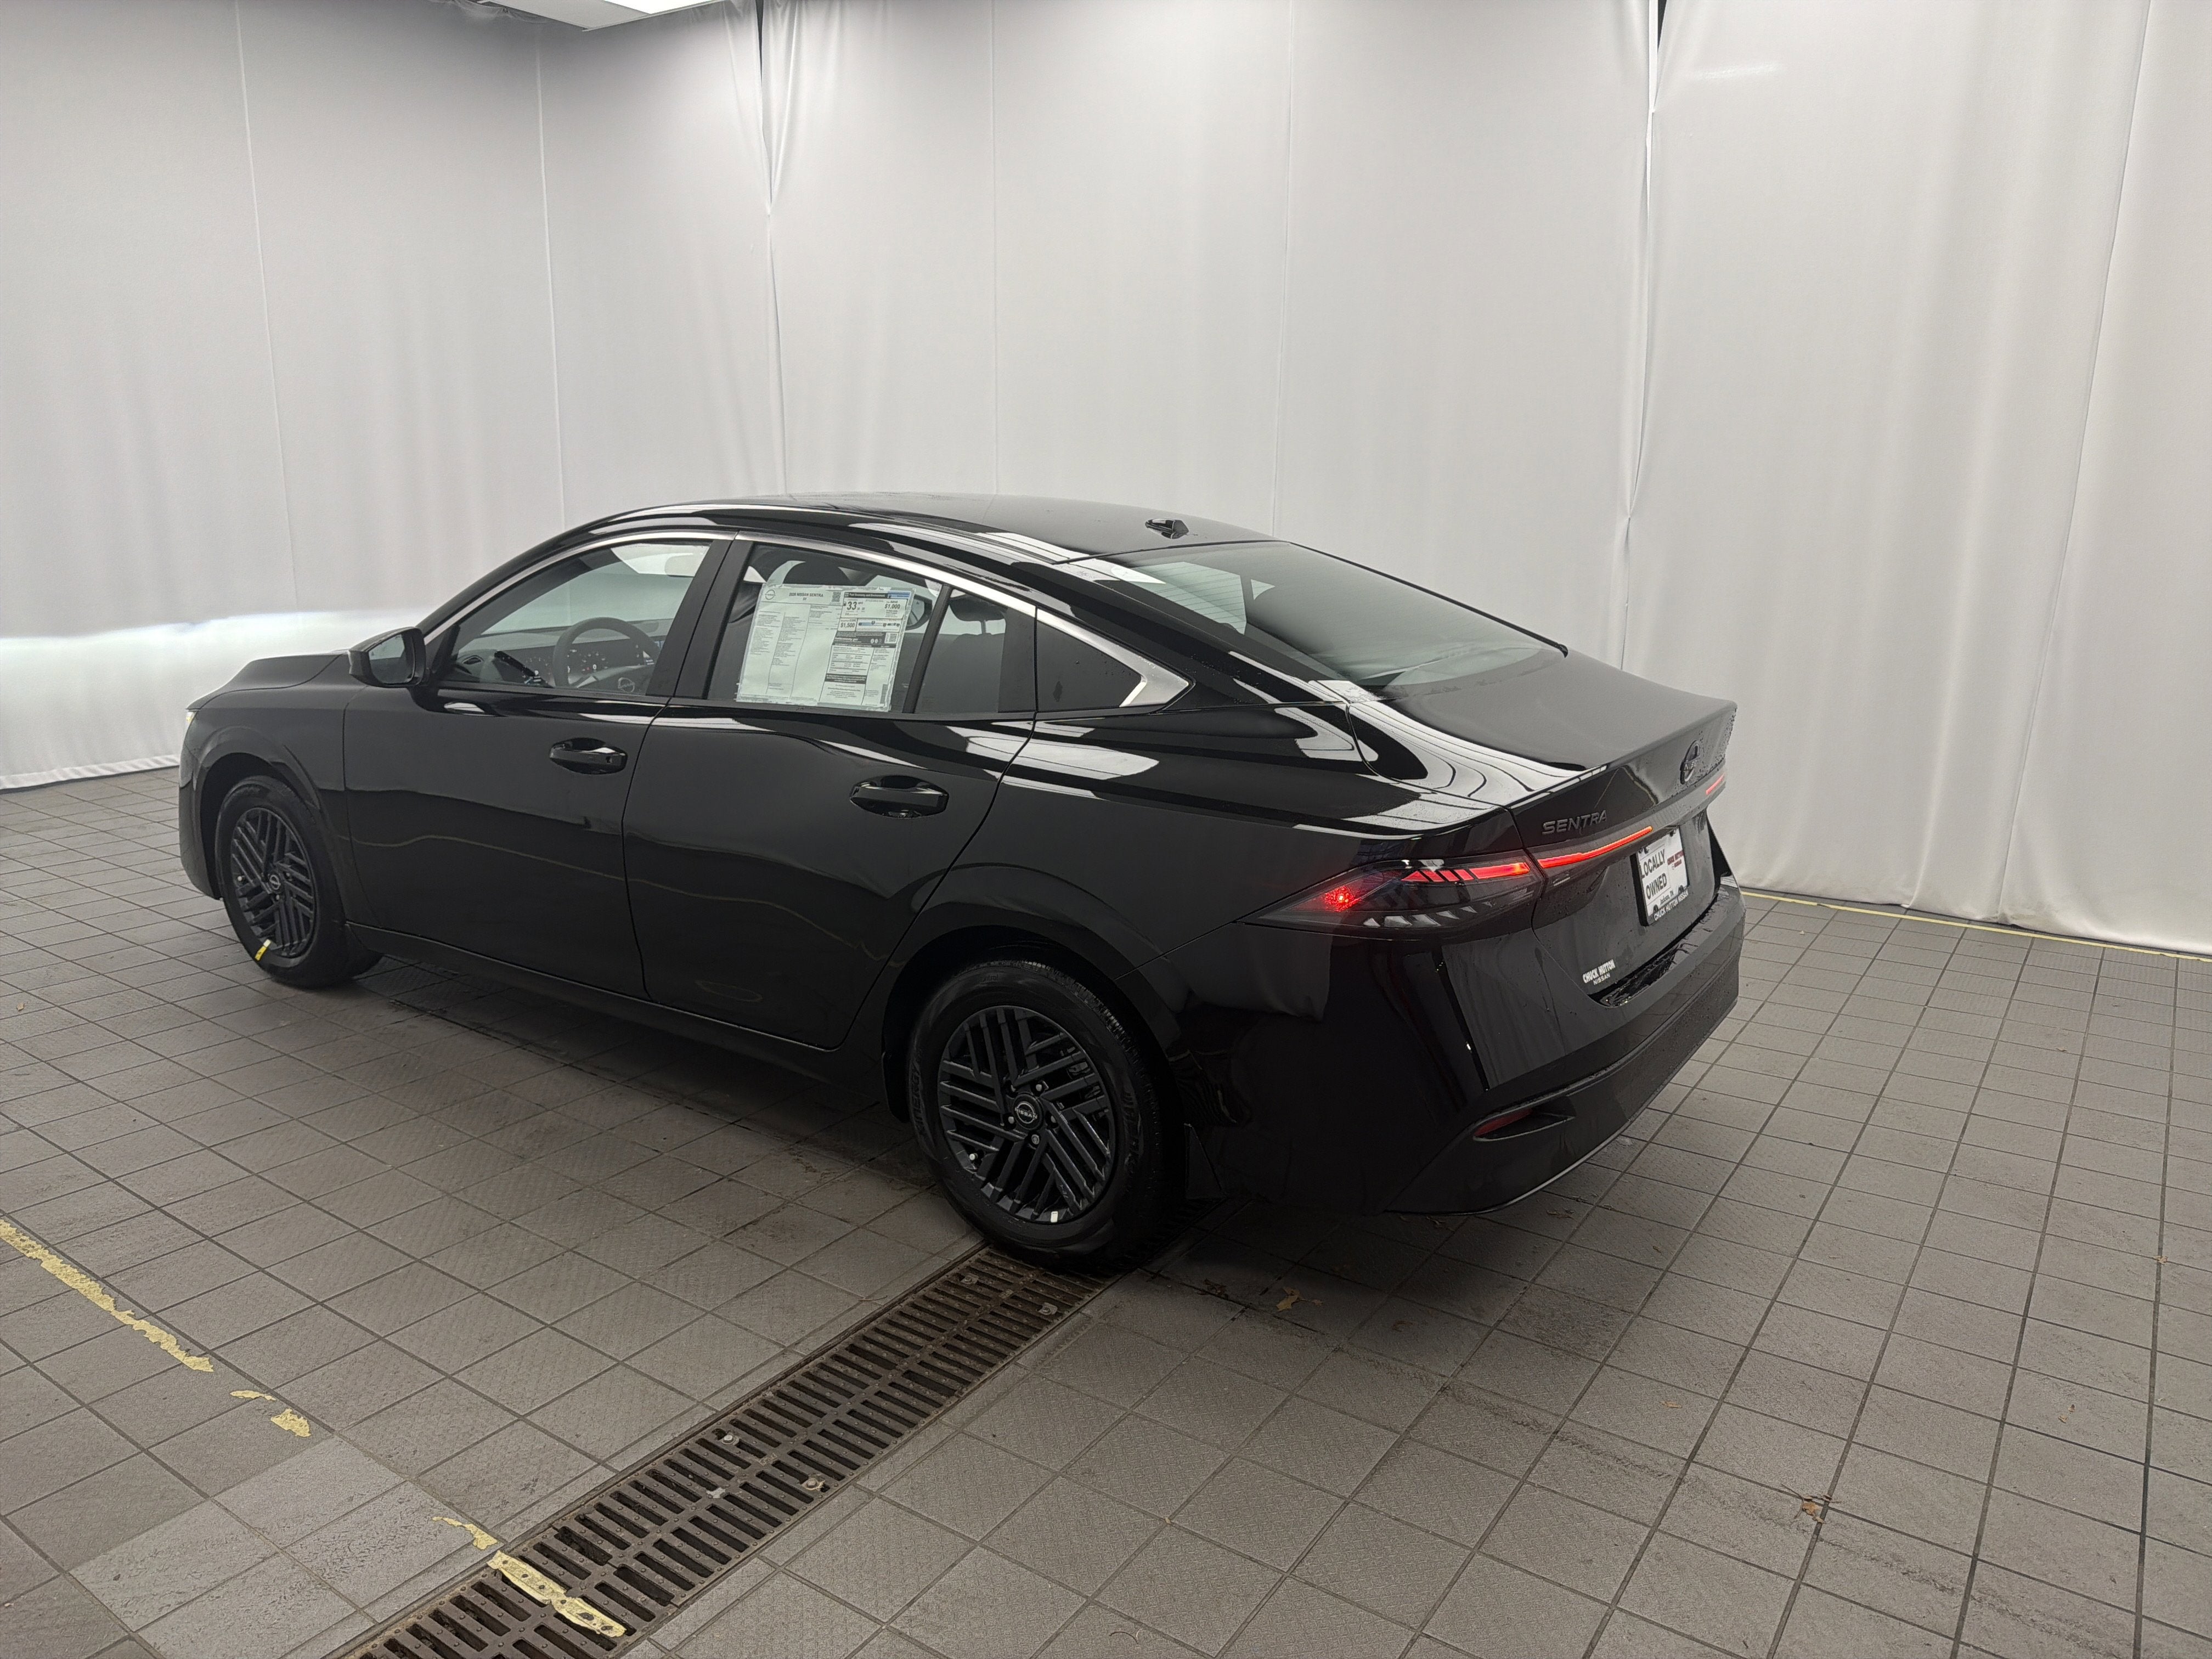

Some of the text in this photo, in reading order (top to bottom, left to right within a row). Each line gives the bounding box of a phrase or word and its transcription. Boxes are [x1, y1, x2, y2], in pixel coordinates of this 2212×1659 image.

[847, 601, 857, 610] 33
[1542, 810, 1607, 834] SENTRA
[1640, 849, 1666, 879] LOCALLY
[1646, 873, 1667, 900] OWNED
[1654, 906, 1666, 921] CHUCK
[1666, 897, 1678, 913] HUTTON
[1583, 959, 1616, 983] CHUCK HUTTON
[1593, 972, 1611, 985] NISSAN
[1014, 1107, 1037, 1119] NISSAN
